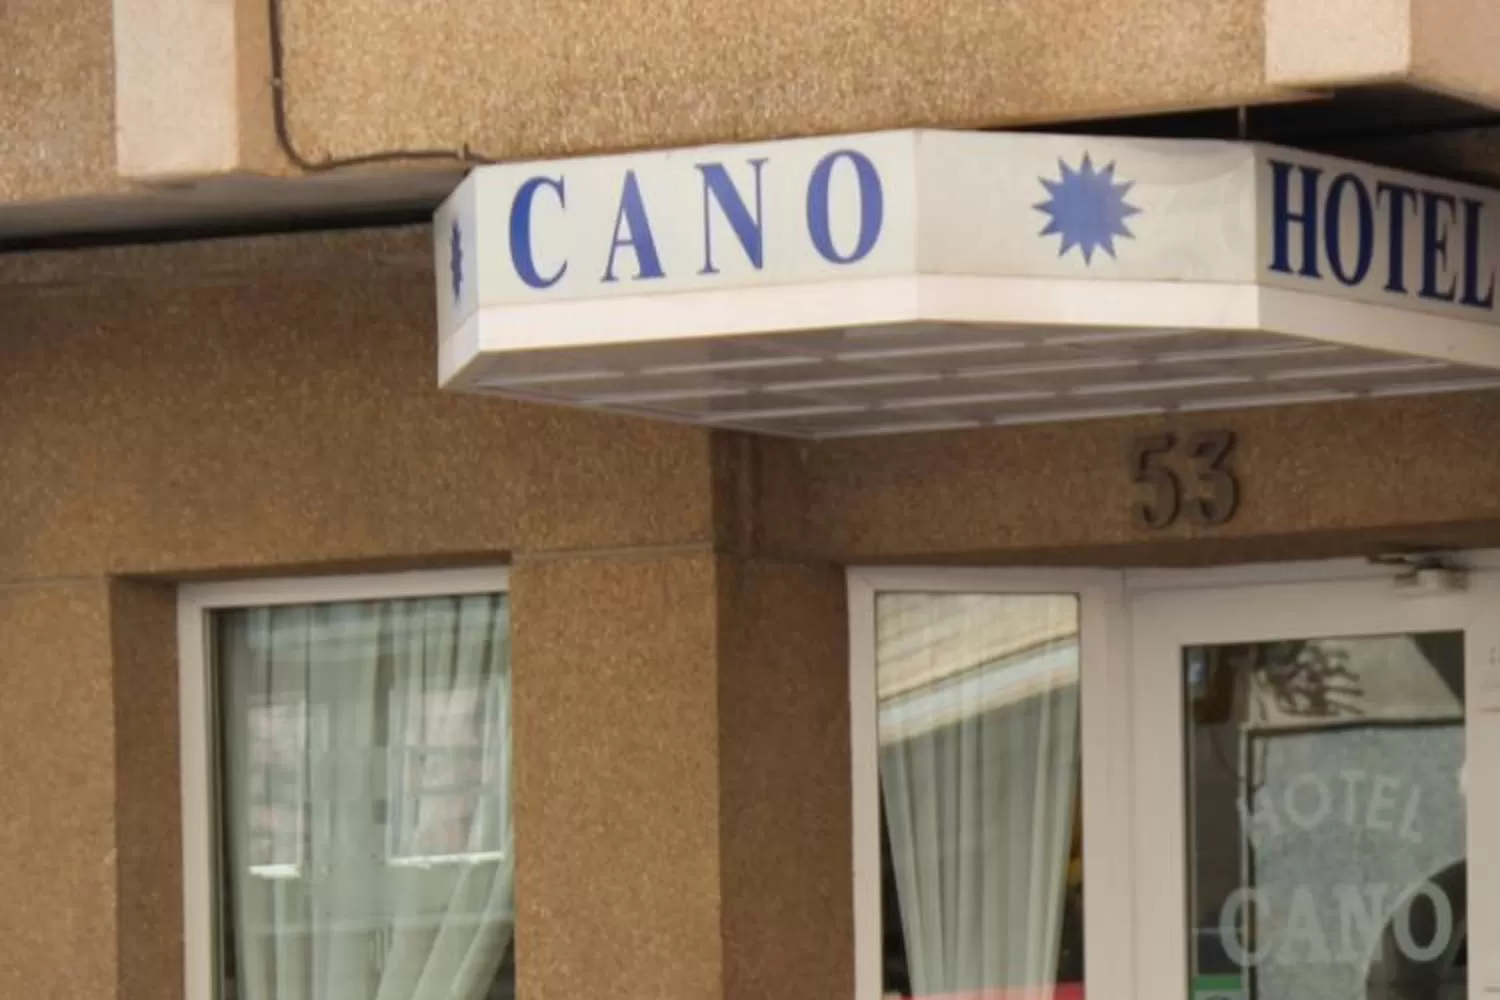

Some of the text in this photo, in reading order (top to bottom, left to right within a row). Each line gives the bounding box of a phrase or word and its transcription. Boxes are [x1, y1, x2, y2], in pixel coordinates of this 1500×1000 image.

[509, 149, 884, 289] CANO
[1268, 159, 1495, 310] HOTEL
[1130, 430, 1240, 529] 53
[1237, 770, 1423, 843] HOTEL
[1220, 880, 1453, 964] CANO
